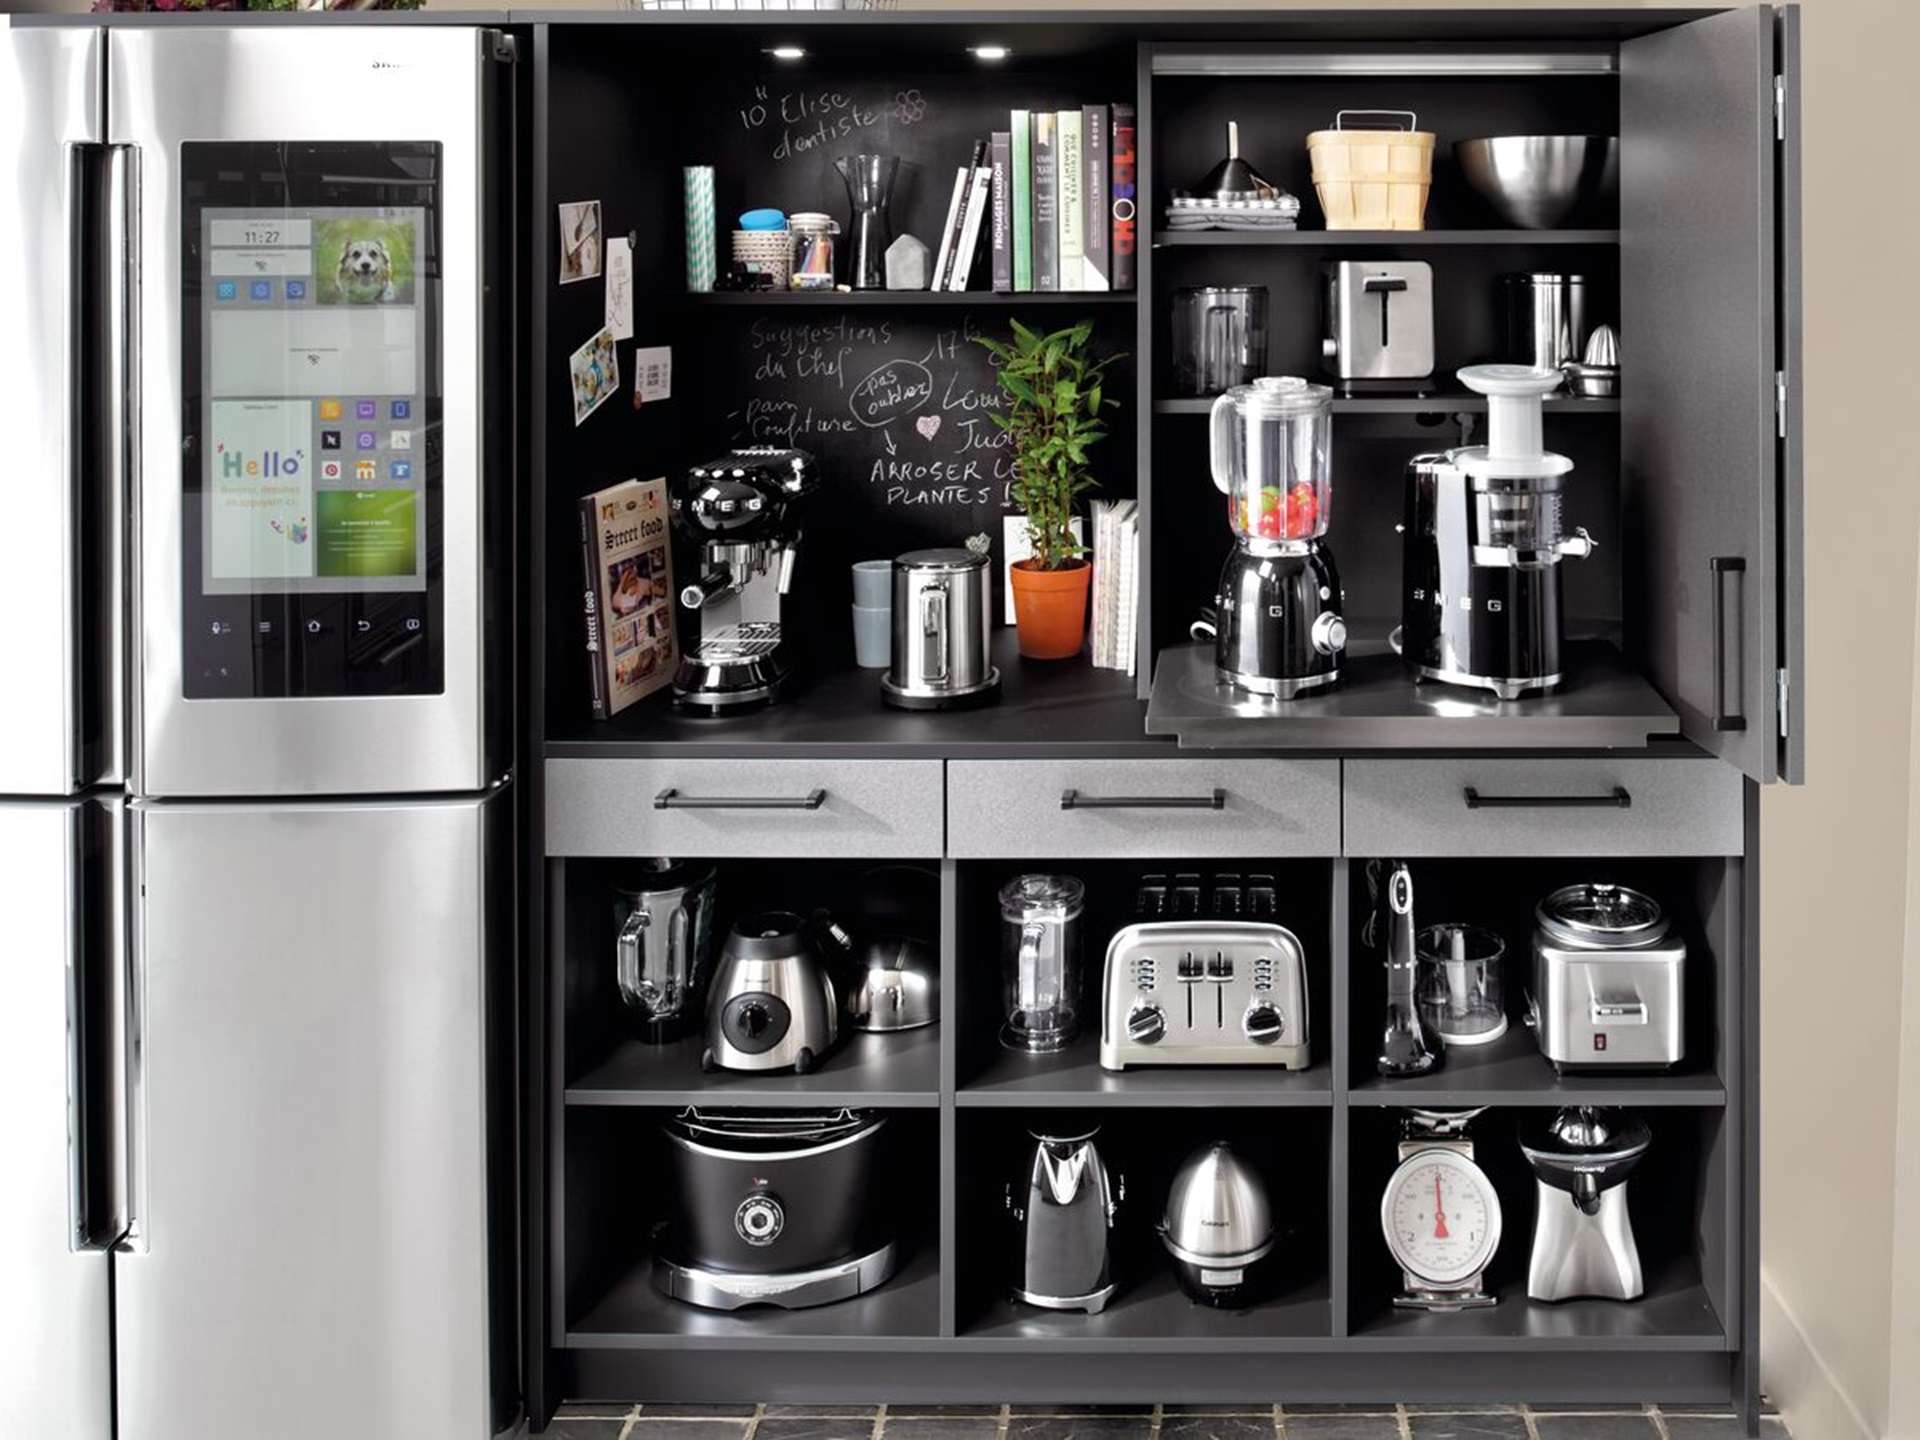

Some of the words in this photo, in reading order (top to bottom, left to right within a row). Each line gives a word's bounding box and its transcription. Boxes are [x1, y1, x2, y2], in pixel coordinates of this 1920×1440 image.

[772, 106, 878, 160] dentiste
[993, 162, 1003, 199] MAISON
[244, 230, 280, 244] 11:27
[994, 200, 1004, 250] FROMAGES
[751, 314, 892, 357] Suggestions
[755, 353, 787, 381] du
[223, 450, 299, 478] Hello
[871, 459, 982, 483] ARROSER
[672, 497, 762, 513] SMEG
[887, 486, 991, 505] PLANTES
